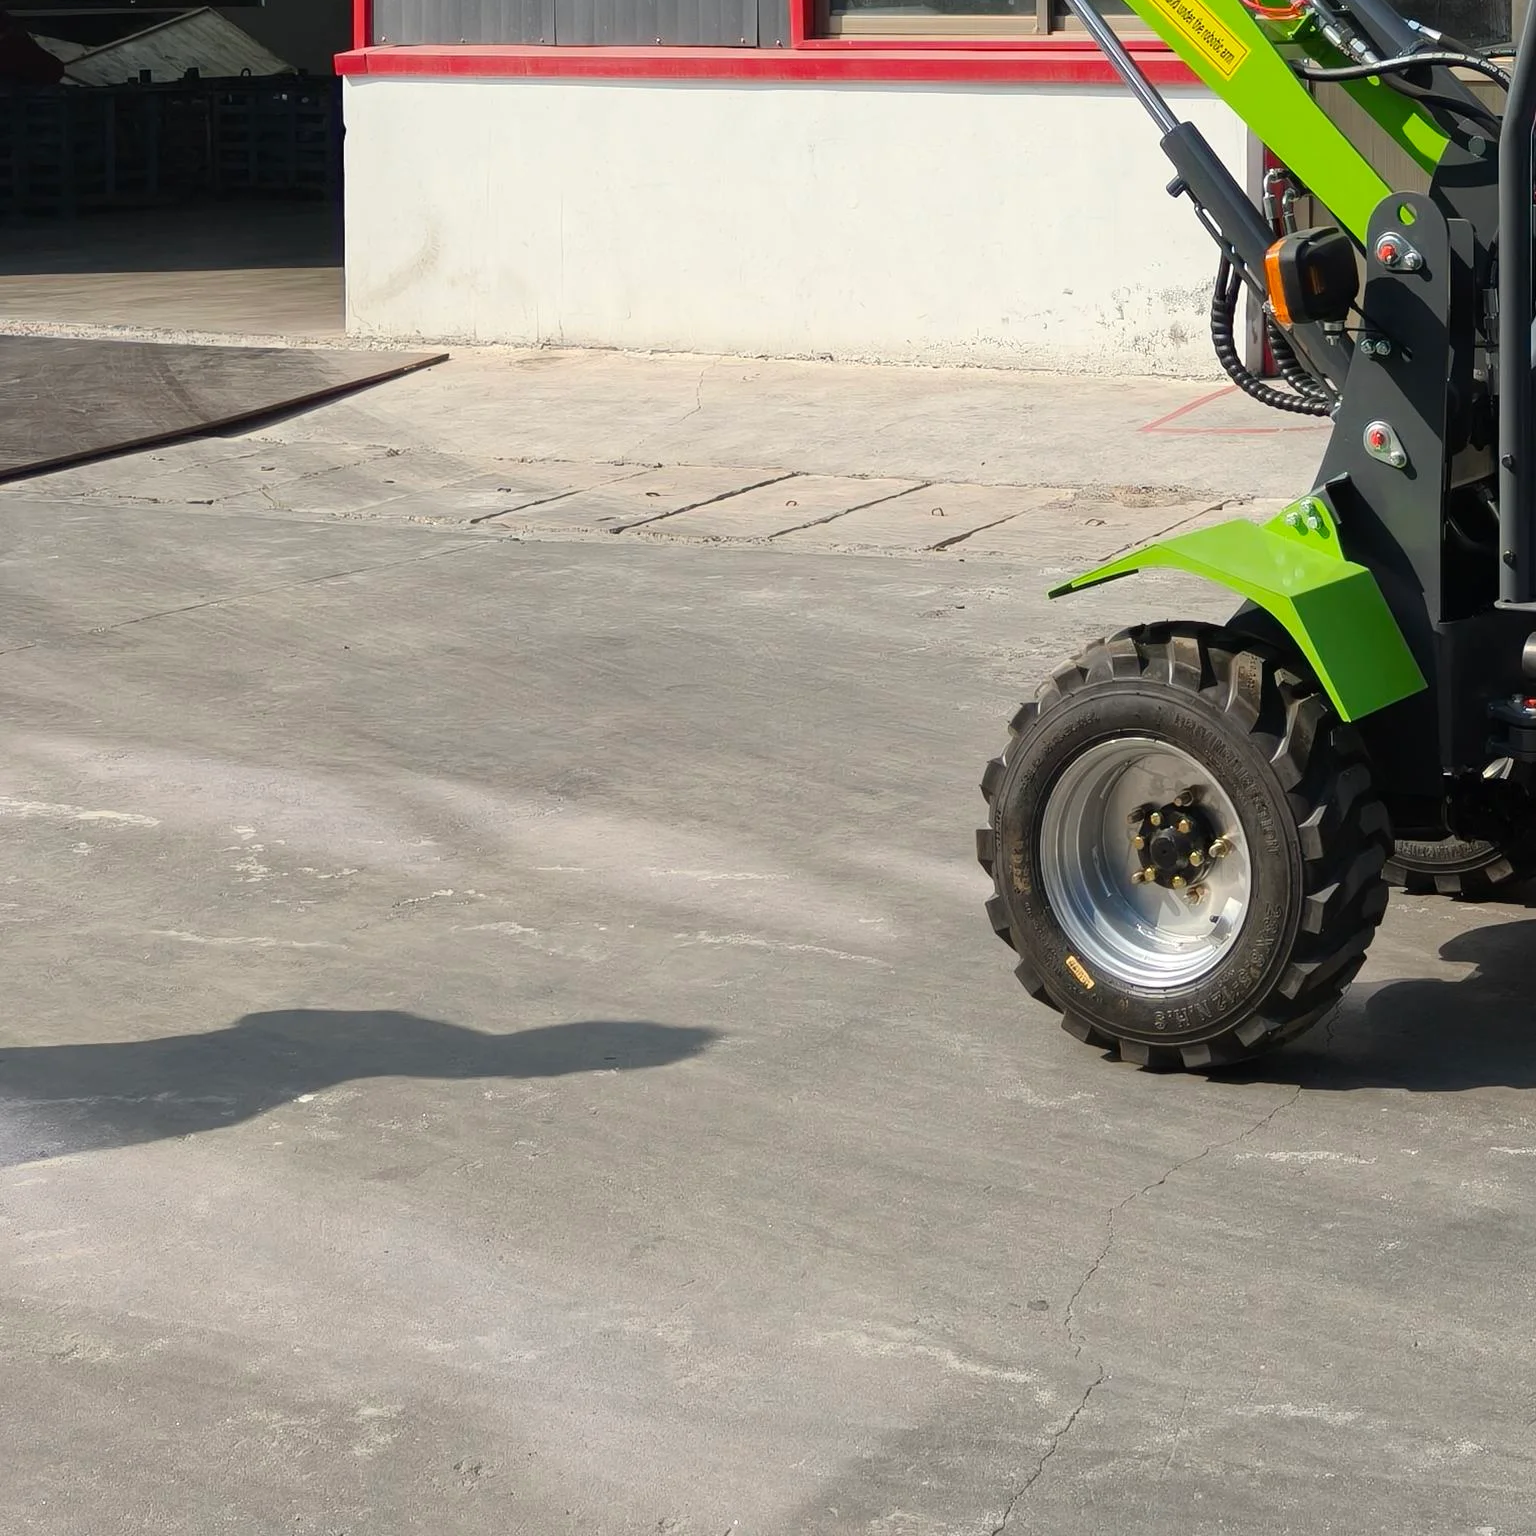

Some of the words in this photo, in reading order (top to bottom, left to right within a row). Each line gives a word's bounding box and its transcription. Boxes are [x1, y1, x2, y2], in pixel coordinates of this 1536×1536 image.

[1177, 5, 1195, 24] under
[1192, 17, 1205, 35] the
[1201, 29, 1224, 54] robotic
[1220, 48, 1235, 65] arm
